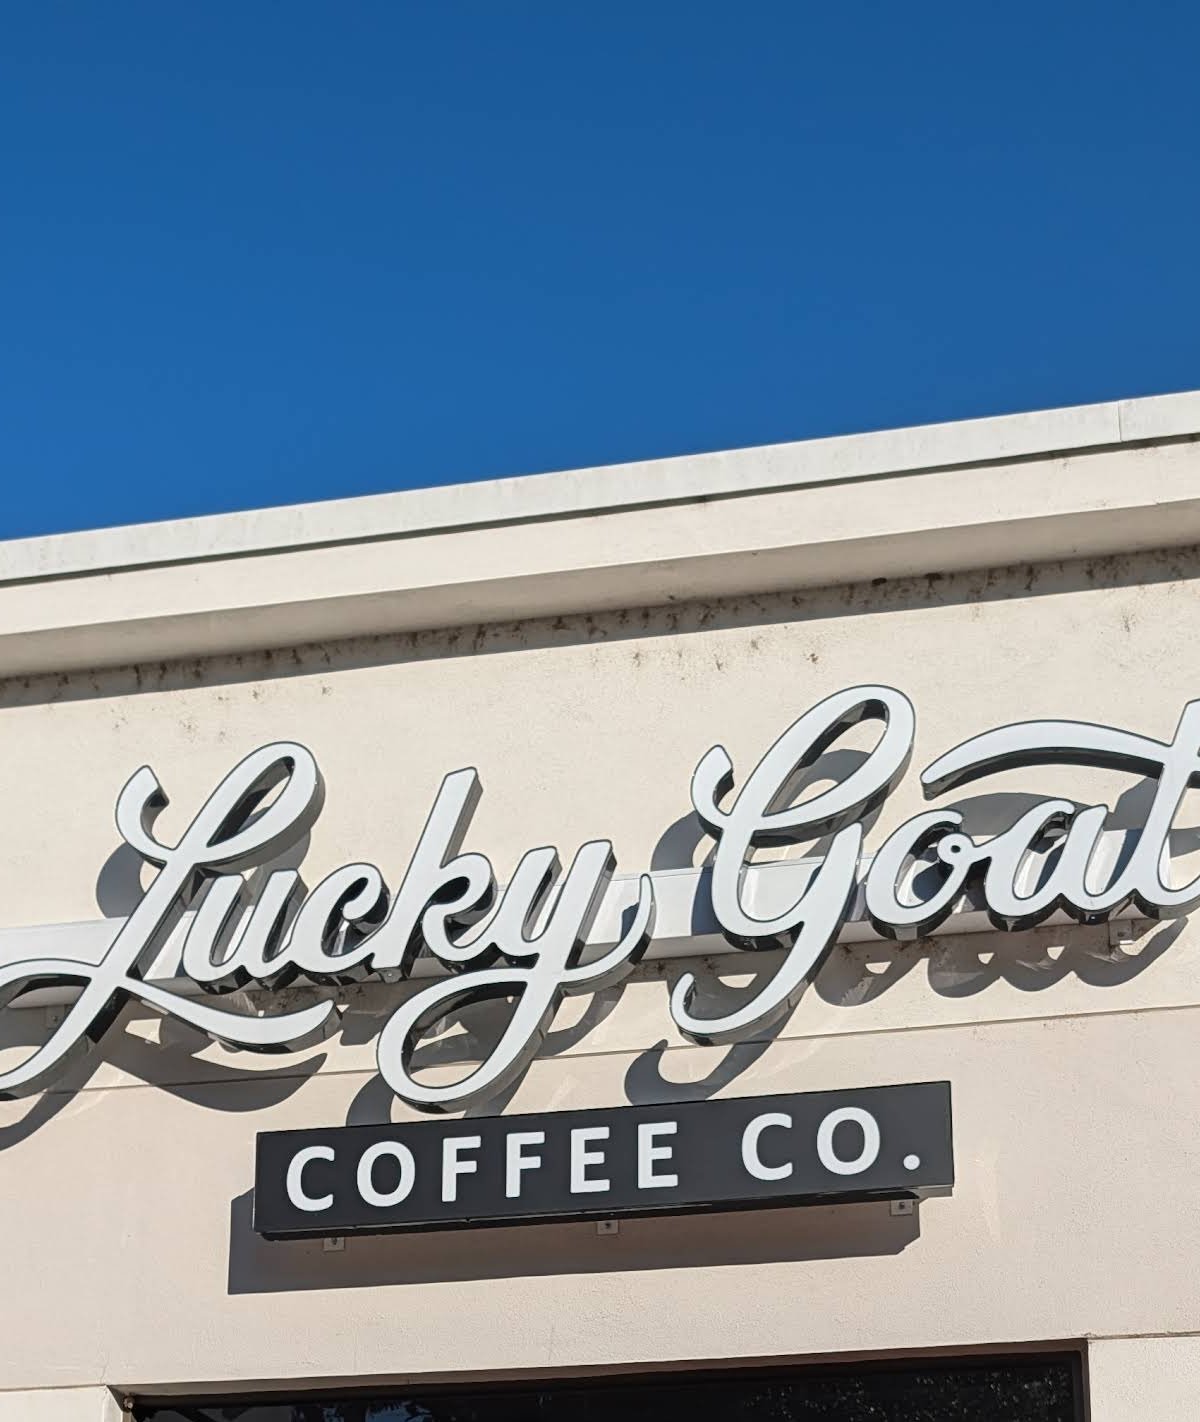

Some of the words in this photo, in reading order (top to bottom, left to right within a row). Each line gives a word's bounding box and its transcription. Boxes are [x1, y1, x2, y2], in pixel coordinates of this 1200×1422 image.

[0, 741, 654, 1110] Lucky
[668, 685, 1200, 1042] Goat
[286, 1122, 679, 1211] COFFEE
[741, 1107, 923, 1181] CO.
